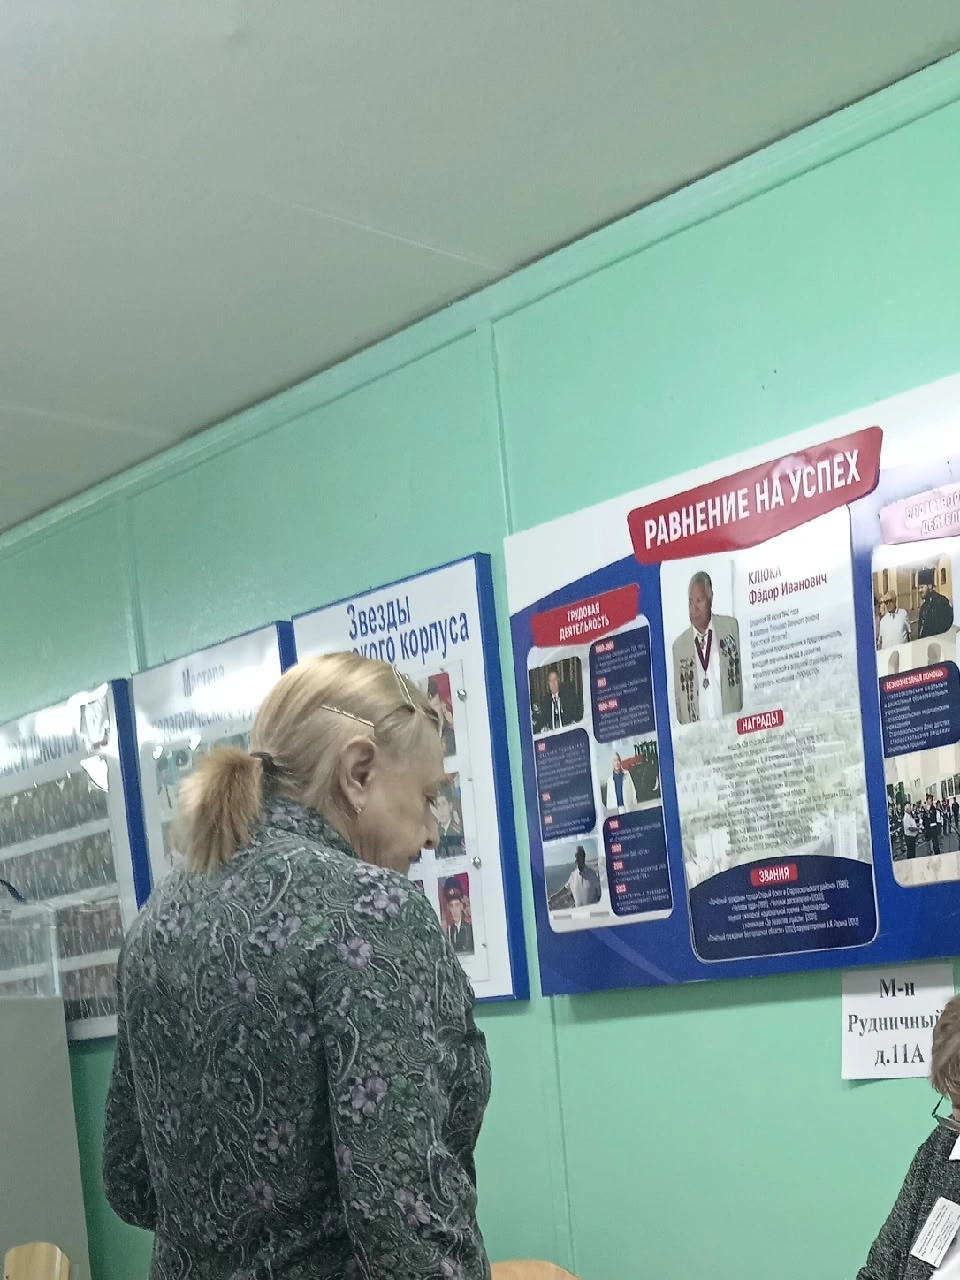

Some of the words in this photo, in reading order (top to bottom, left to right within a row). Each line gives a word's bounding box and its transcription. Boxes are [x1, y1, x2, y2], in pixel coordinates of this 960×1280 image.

[644, 487, 750, 549] РАВНЕНИЕ
[755, 475, 785, 513] НА
[787, 449, 861, 504] УСПЕХ
[748, 566, 782, 586] КЛЮКА
[748, 586, 779, 606] Фёдор
[781, 573, 828, 597] Иванович
[346, 595, 411, 640] Звезды
[559, 615, 610, 641] ДЕЯТЕЛЬНОСТЬ
[400, 611, 470, 665] корпуса
[742, 711, 779, 732] НАГРАДЫ
[758, 866, 790, 883] ЗВАНИЯ
[879, 978, 916, 999] М-н
[874, 1043, 926, 1067] д.11А
